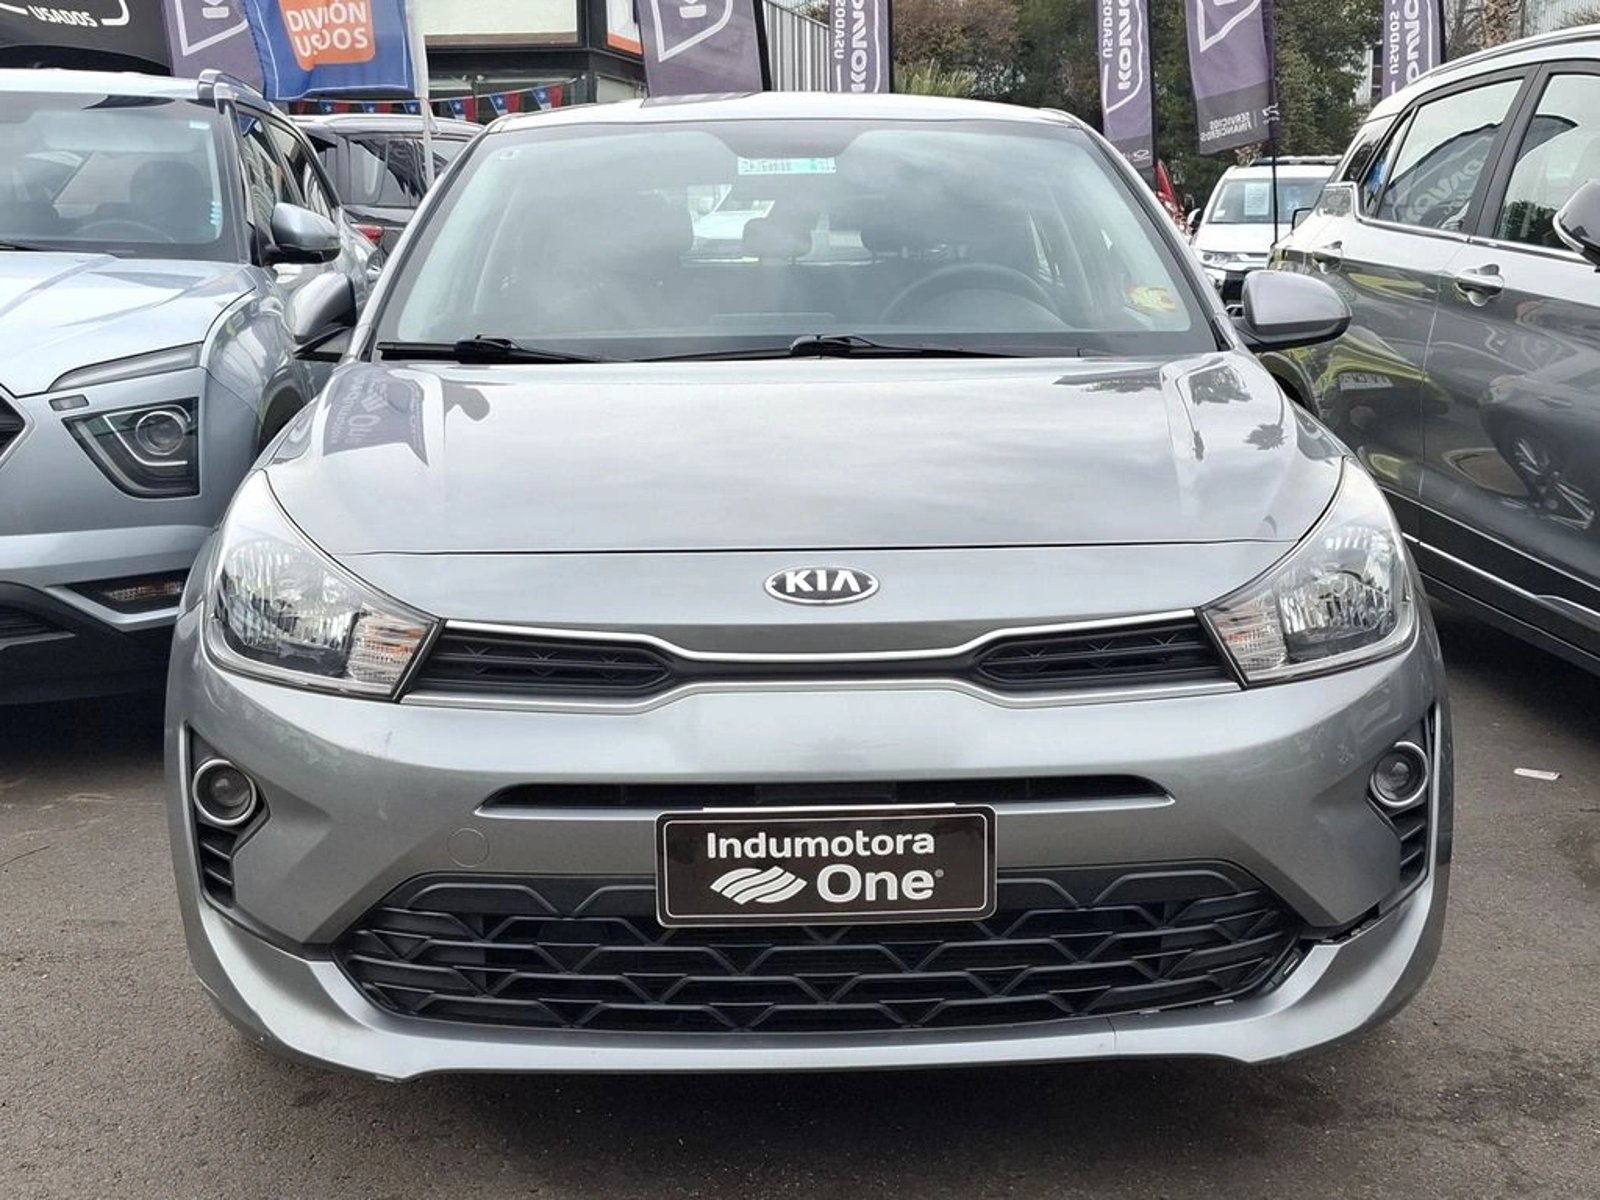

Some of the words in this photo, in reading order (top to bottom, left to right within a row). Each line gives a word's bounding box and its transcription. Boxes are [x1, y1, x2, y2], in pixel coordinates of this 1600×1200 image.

[27, 5, 98, 27] USADOS
[785, 570, 861, 593] KIA
[707, 830, 935, 858] Indumotora
[817, 864, 935, 903] One
